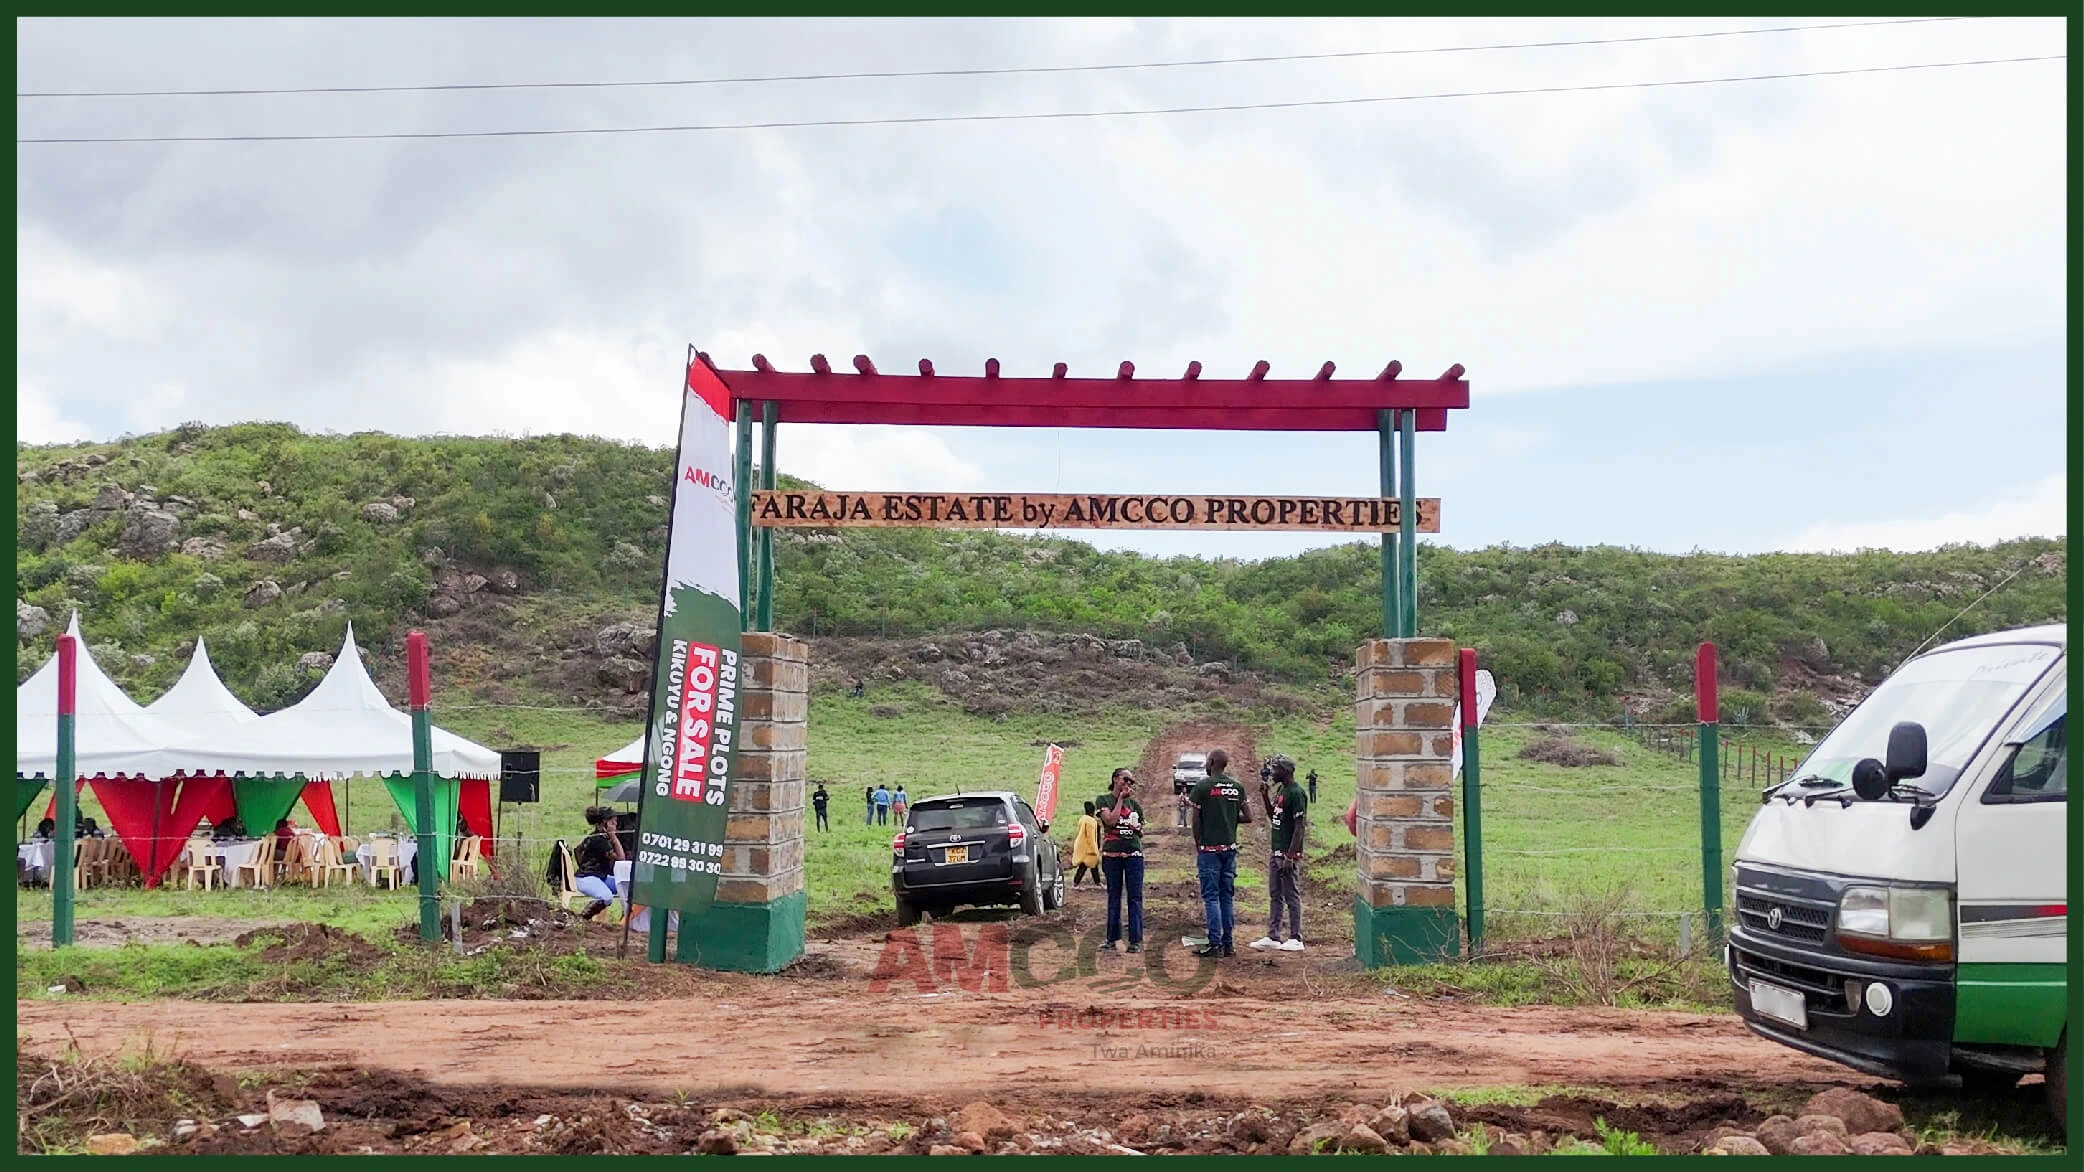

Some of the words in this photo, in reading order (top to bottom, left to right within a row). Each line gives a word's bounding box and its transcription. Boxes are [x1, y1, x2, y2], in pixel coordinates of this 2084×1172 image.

[881, 495, 1014, 522] ESTATE
[1022, 496, 1056, 529] by
[1063, 497, 1195, 524] AMCCO
[665, 639, 688, 706] KIKUYU
[686, 646, 717, 715] FOR
[715, 649, 738, 725] PRIME
[664, 710, 679, 724] &
[655, 728, 676, 797] NGONG
[675, 717, 709, 798] SALE
[705, 728, 731, 806] PLOTS
[639, 850, 670, 867] 0722
[688, 859, 705, 872] 30
[705, 862, 722, 874] 30
[642, 832, 673, 849] 0701
[673, 838, 690, 852] 29
[691, 841, 707, 855] 31
